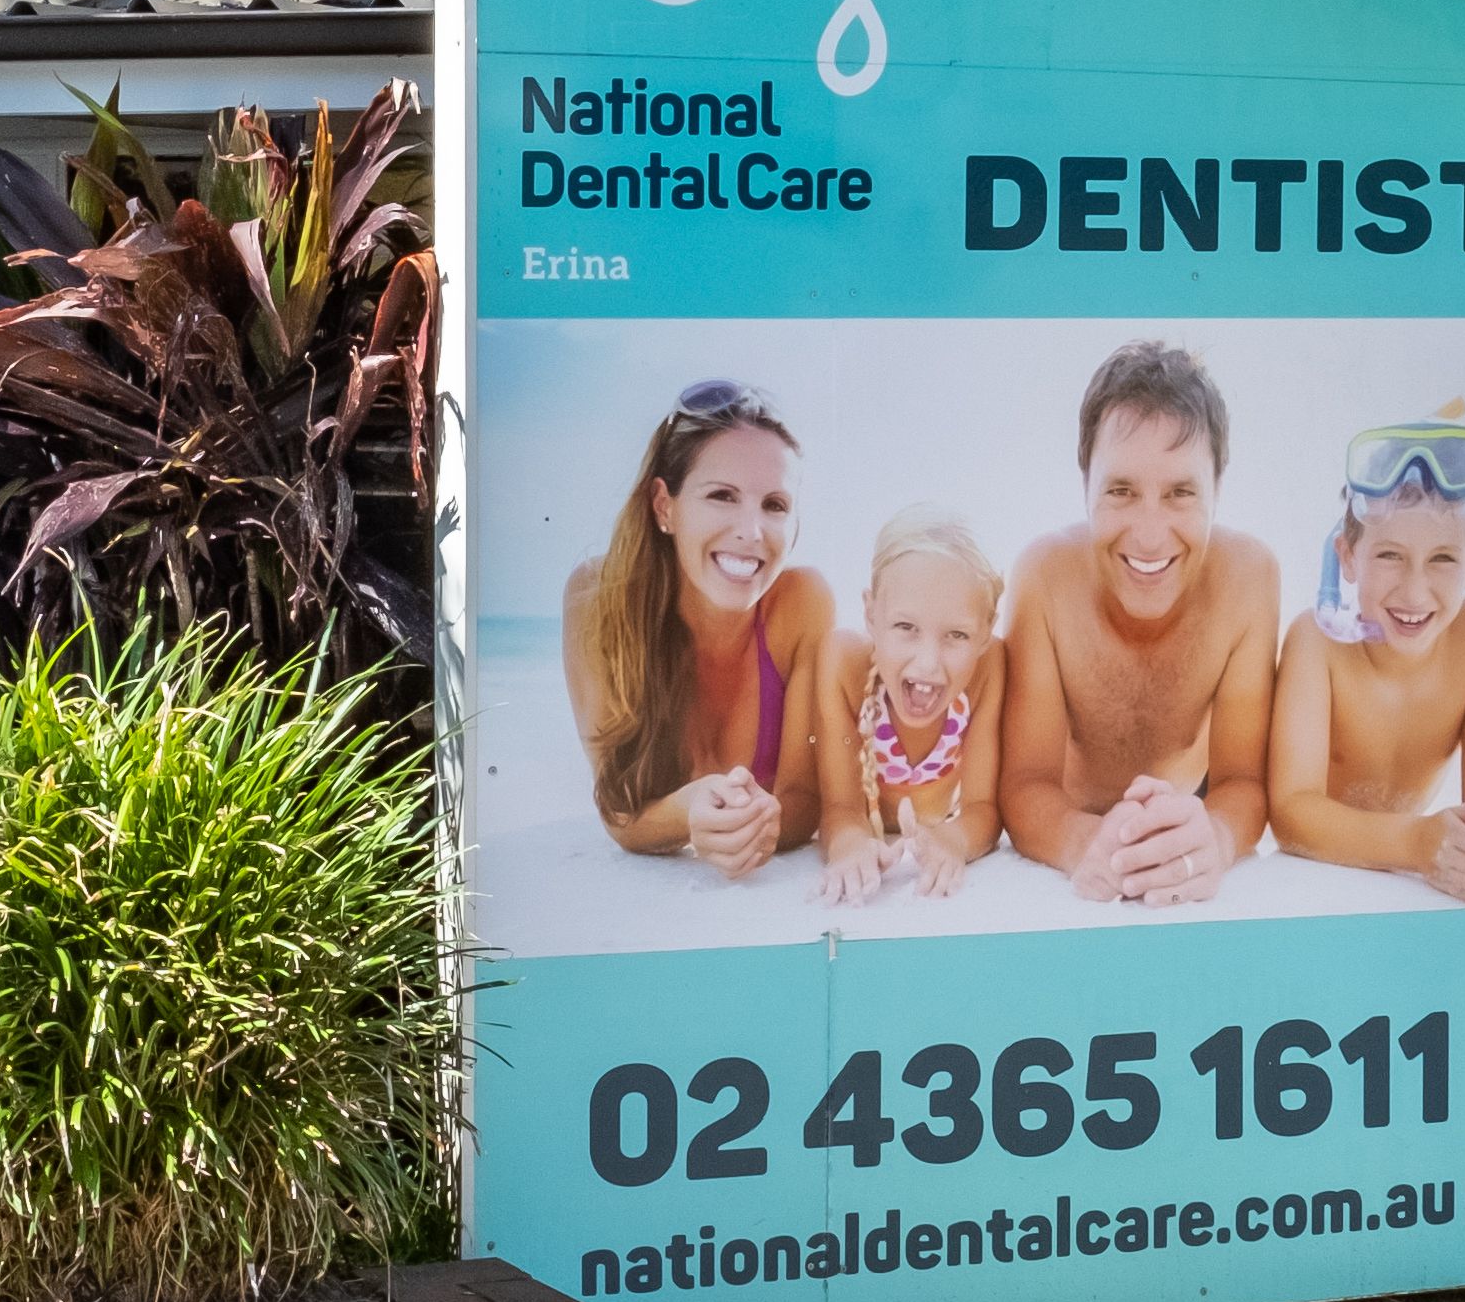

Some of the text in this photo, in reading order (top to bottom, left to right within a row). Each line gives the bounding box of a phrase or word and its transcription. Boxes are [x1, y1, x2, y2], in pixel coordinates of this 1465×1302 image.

[521, 76, 782, 137] National
[522, 247, 630, 281] Erina
[588, 1010, 1452, 1188] 02 4365 1611
[580, 1179, 1456, 1298] nationaldentalcare.com.au
